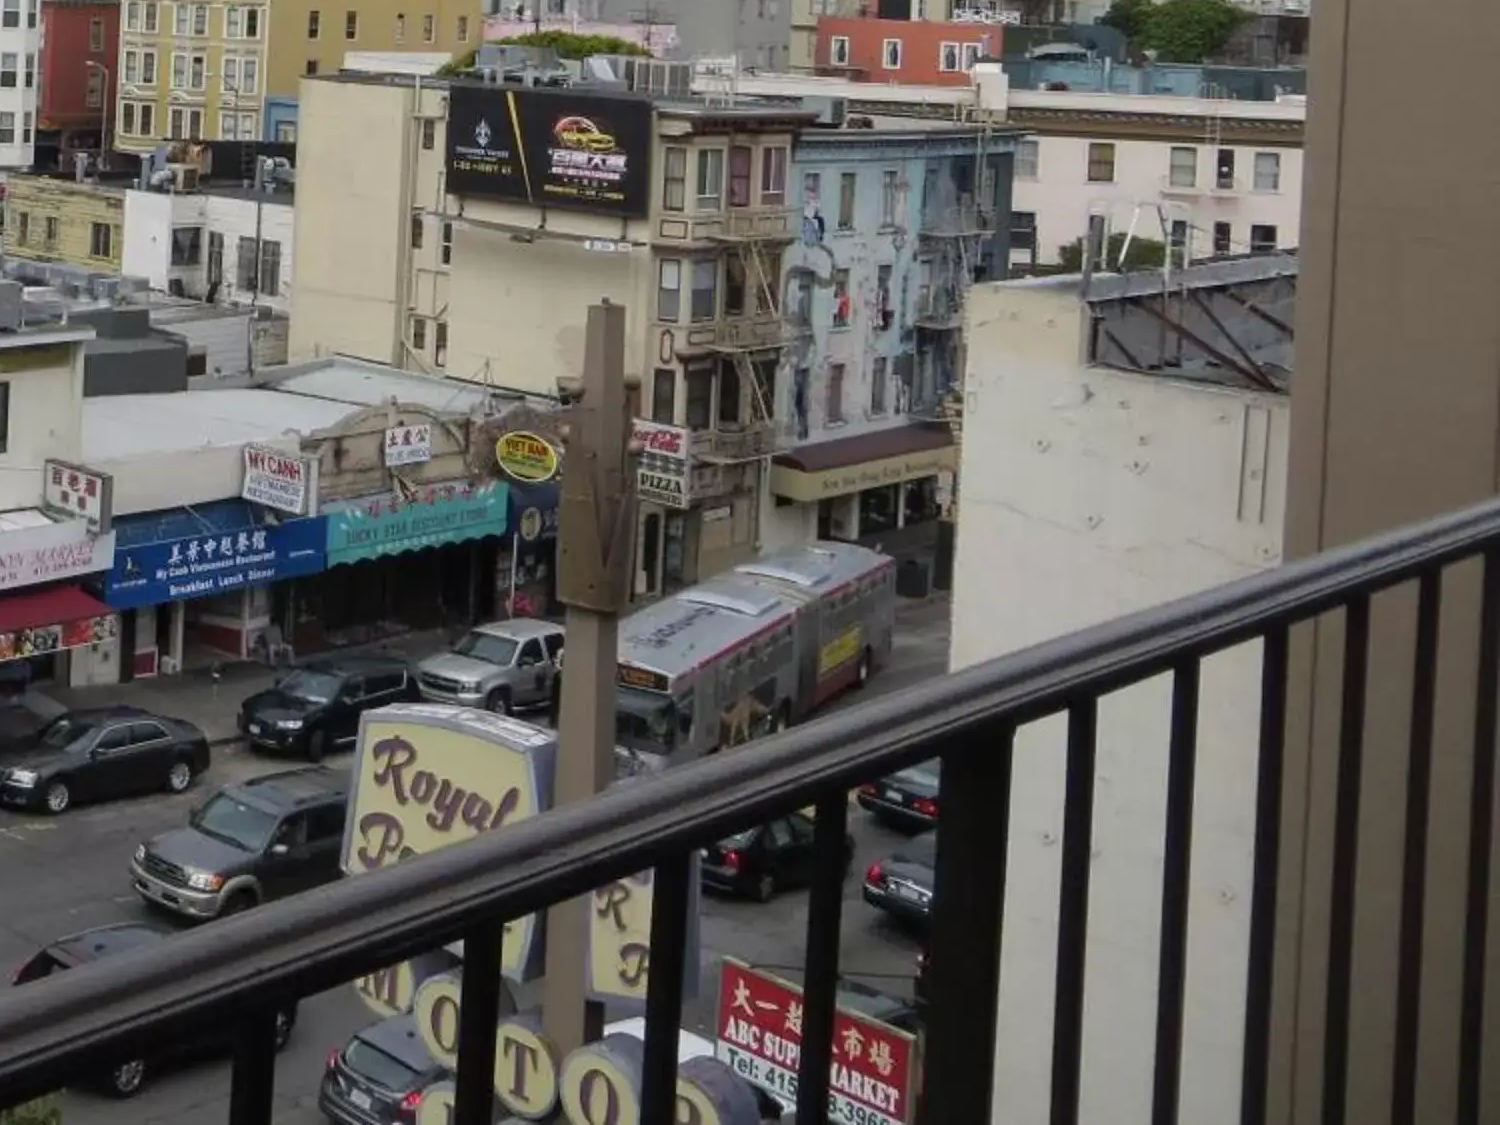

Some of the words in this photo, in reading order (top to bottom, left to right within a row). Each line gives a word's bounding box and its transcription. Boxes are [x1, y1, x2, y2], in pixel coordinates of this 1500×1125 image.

[640, 472, 682, 494] PIZZA
[169, 578, 214, 596] Breakfast
[217, 573, 243, 588] Lunch
[373, 735, 521, 832] Royal
[724, 1014, 761, 1051] ABC
[727, 1047, 759, 1079] Tel:
